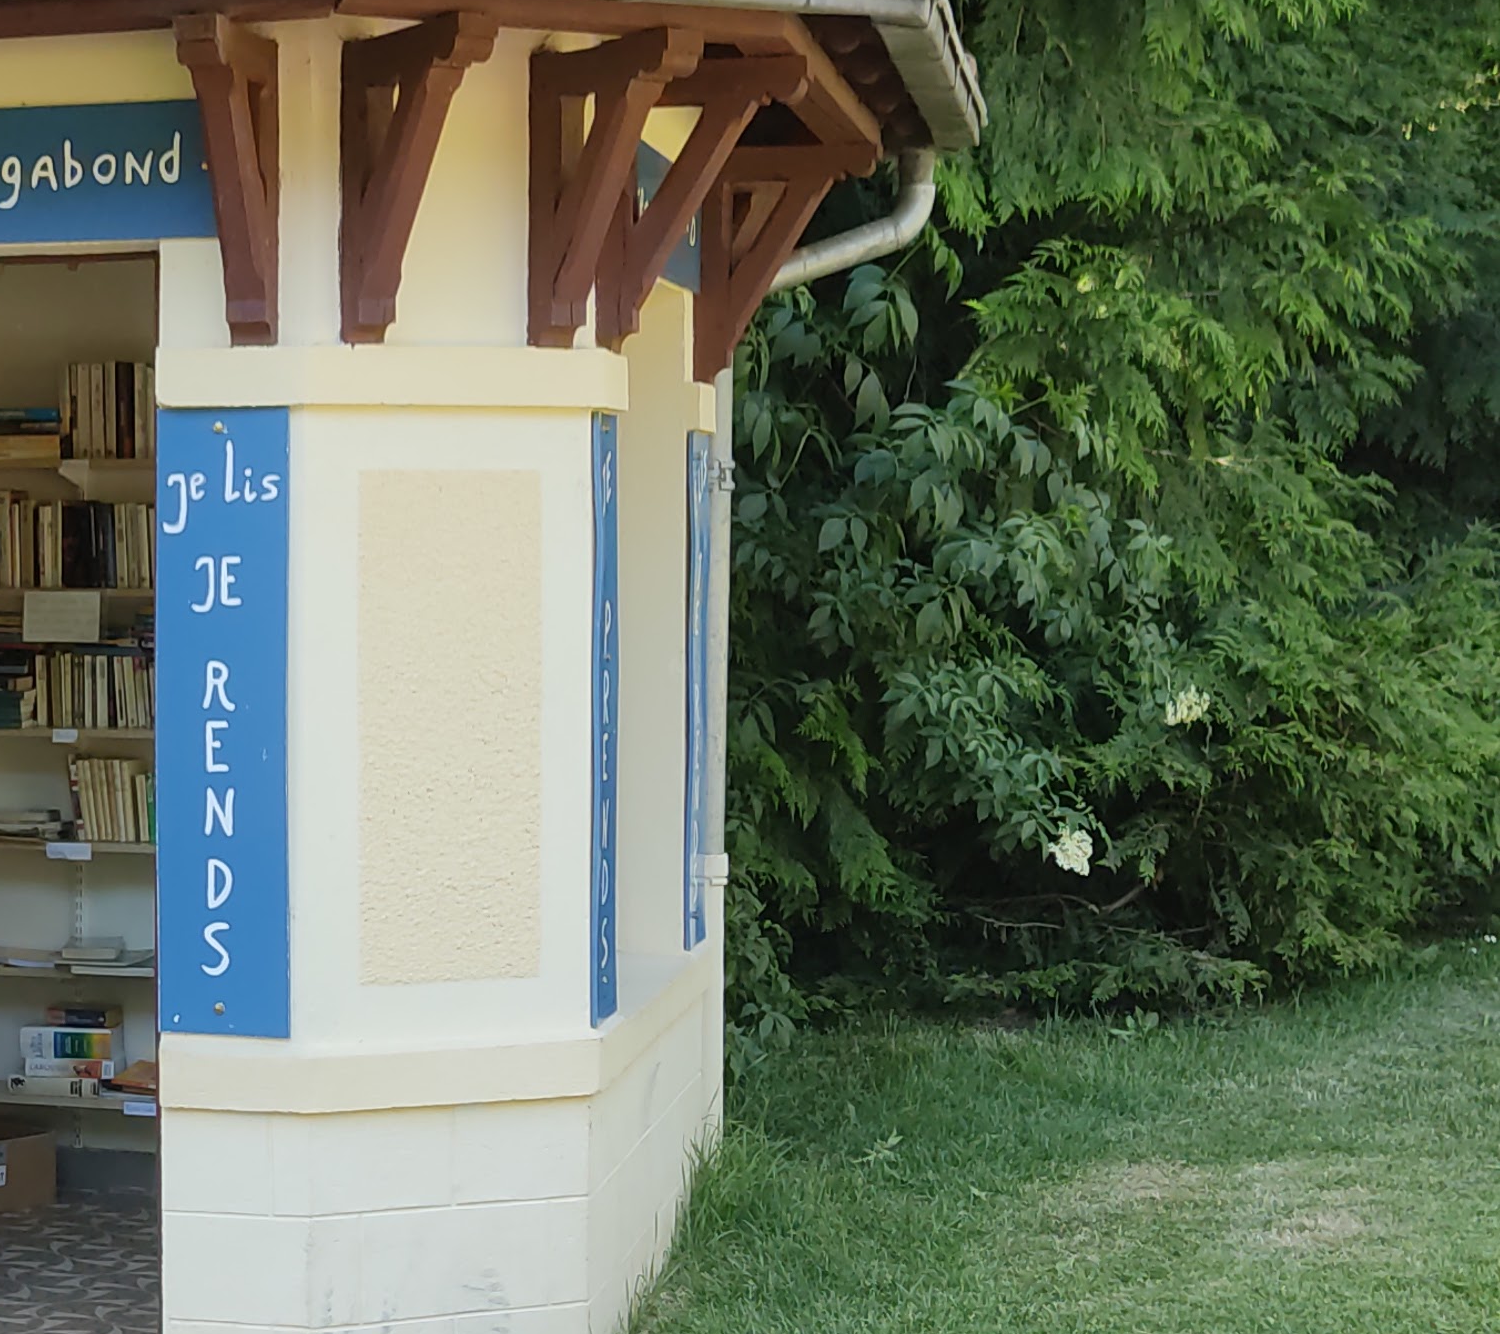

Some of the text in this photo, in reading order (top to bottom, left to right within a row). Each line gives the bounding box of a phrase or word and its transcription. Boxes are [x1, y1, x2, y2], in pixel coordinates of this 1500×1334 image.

[224, 439, 281, 503] lis
[602, 450, 612, 516] JE
[190, 555, 242, 614] JE
[601, 599, 612, 969] PRENDS
[200, 659, 236, 977] RENDS
